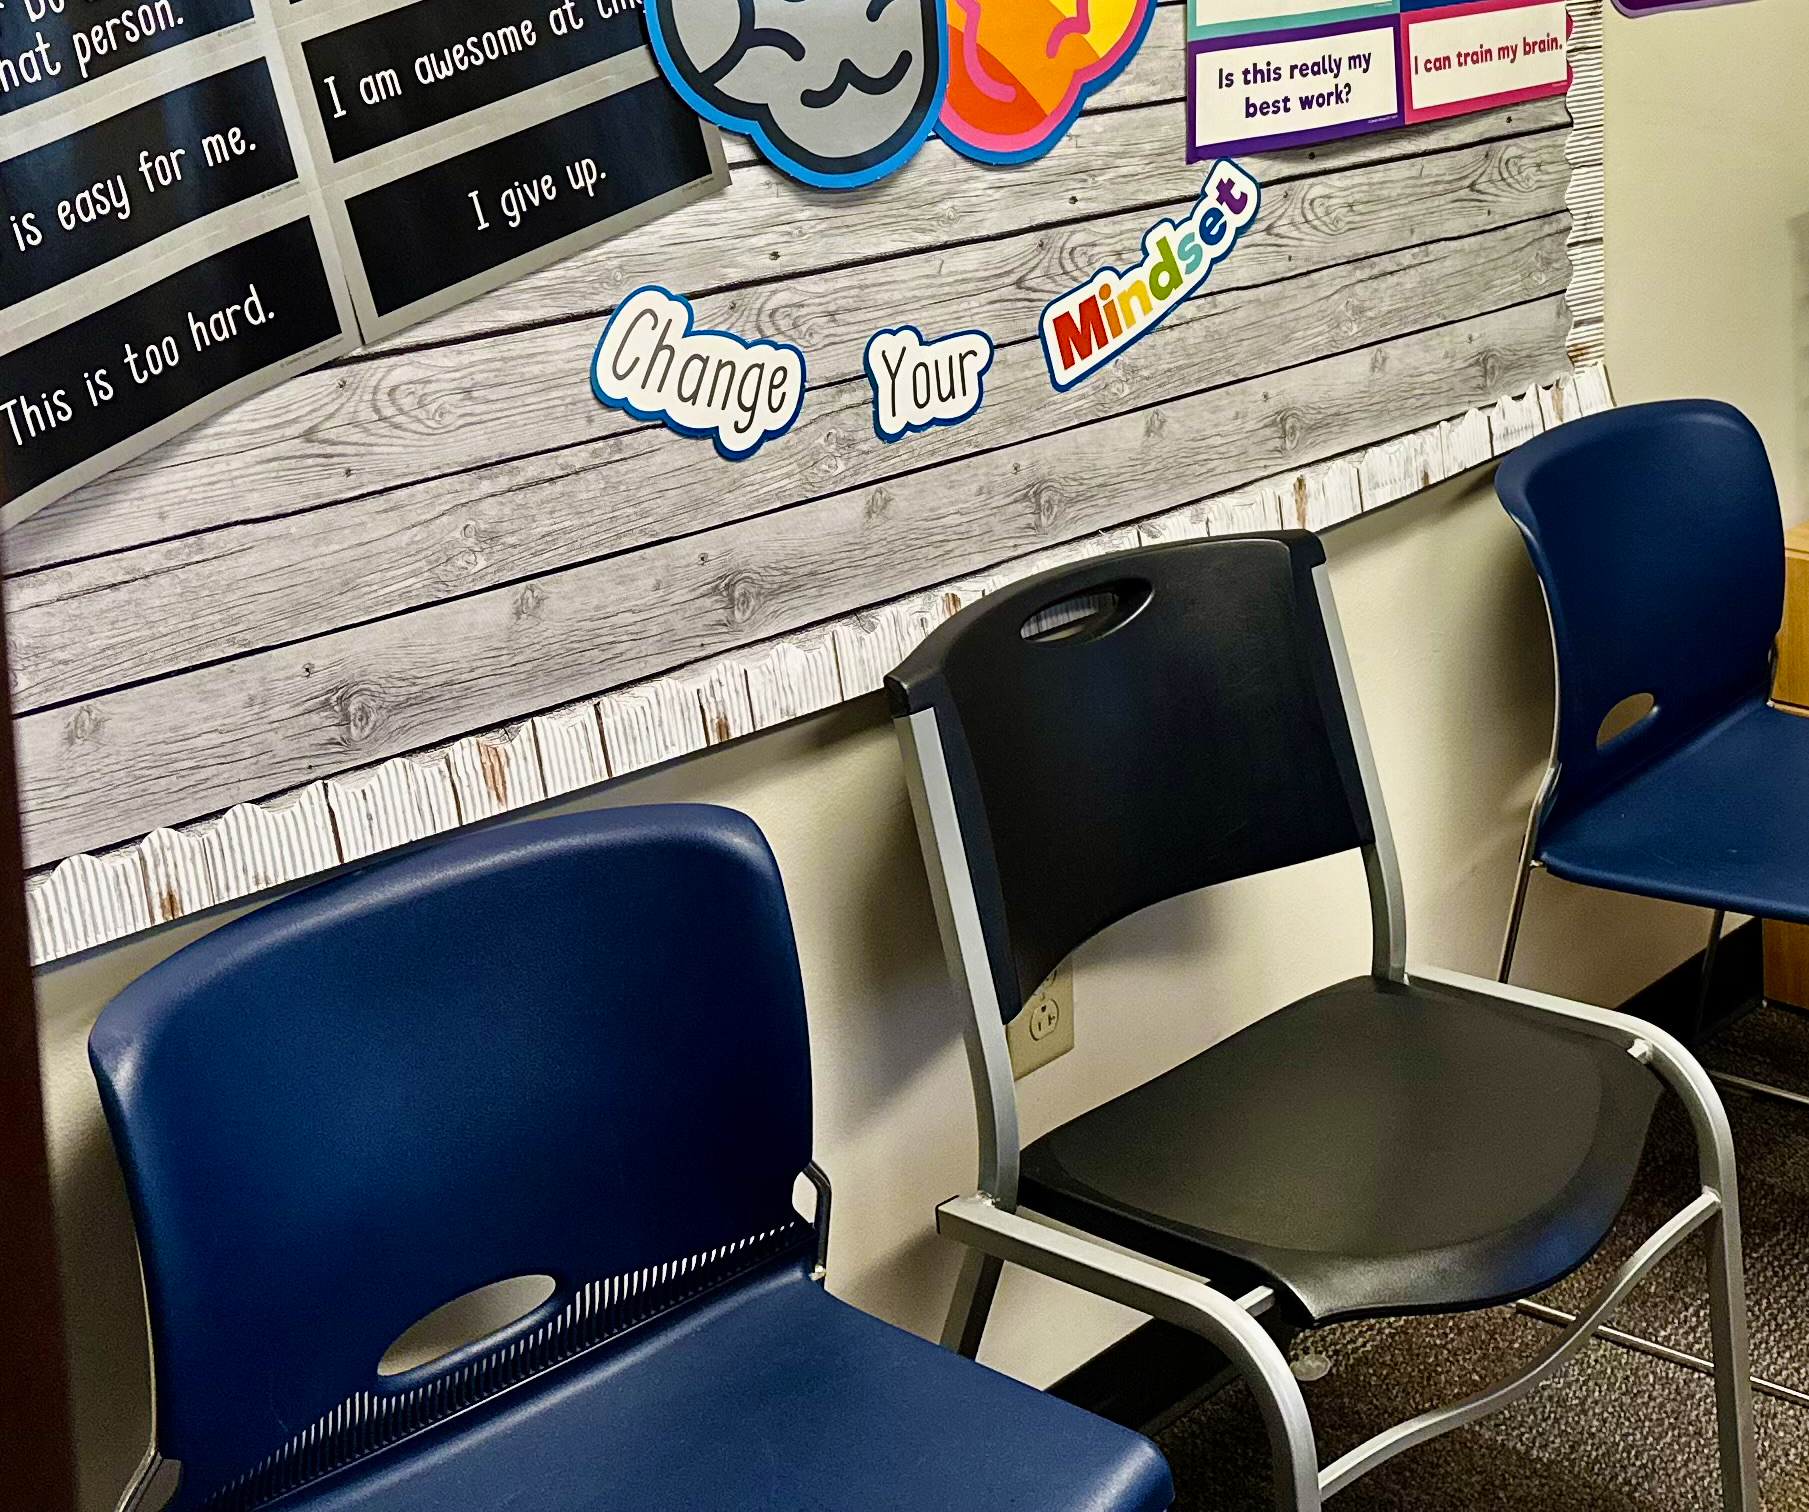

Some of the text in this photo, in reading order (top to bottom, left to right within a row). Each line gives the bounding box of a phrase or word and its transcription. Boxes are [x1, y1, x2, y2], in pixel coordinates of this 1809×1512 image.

[1218, 51, 1372, 90] Is this really my
[1244, 82, 1352, 119] best work?
[10, 125, 257, 252] is easy for me.
[1052, 176, 1248, 371] Mindset
[0, 389, 73, 447] This
[83, 368, 115, 408] is
[123, 334, 181, 385] too
[188, 284, 275, 353] hard.
[612, 308, 788, 435] Change
[880, 345, 978, 419] Your
